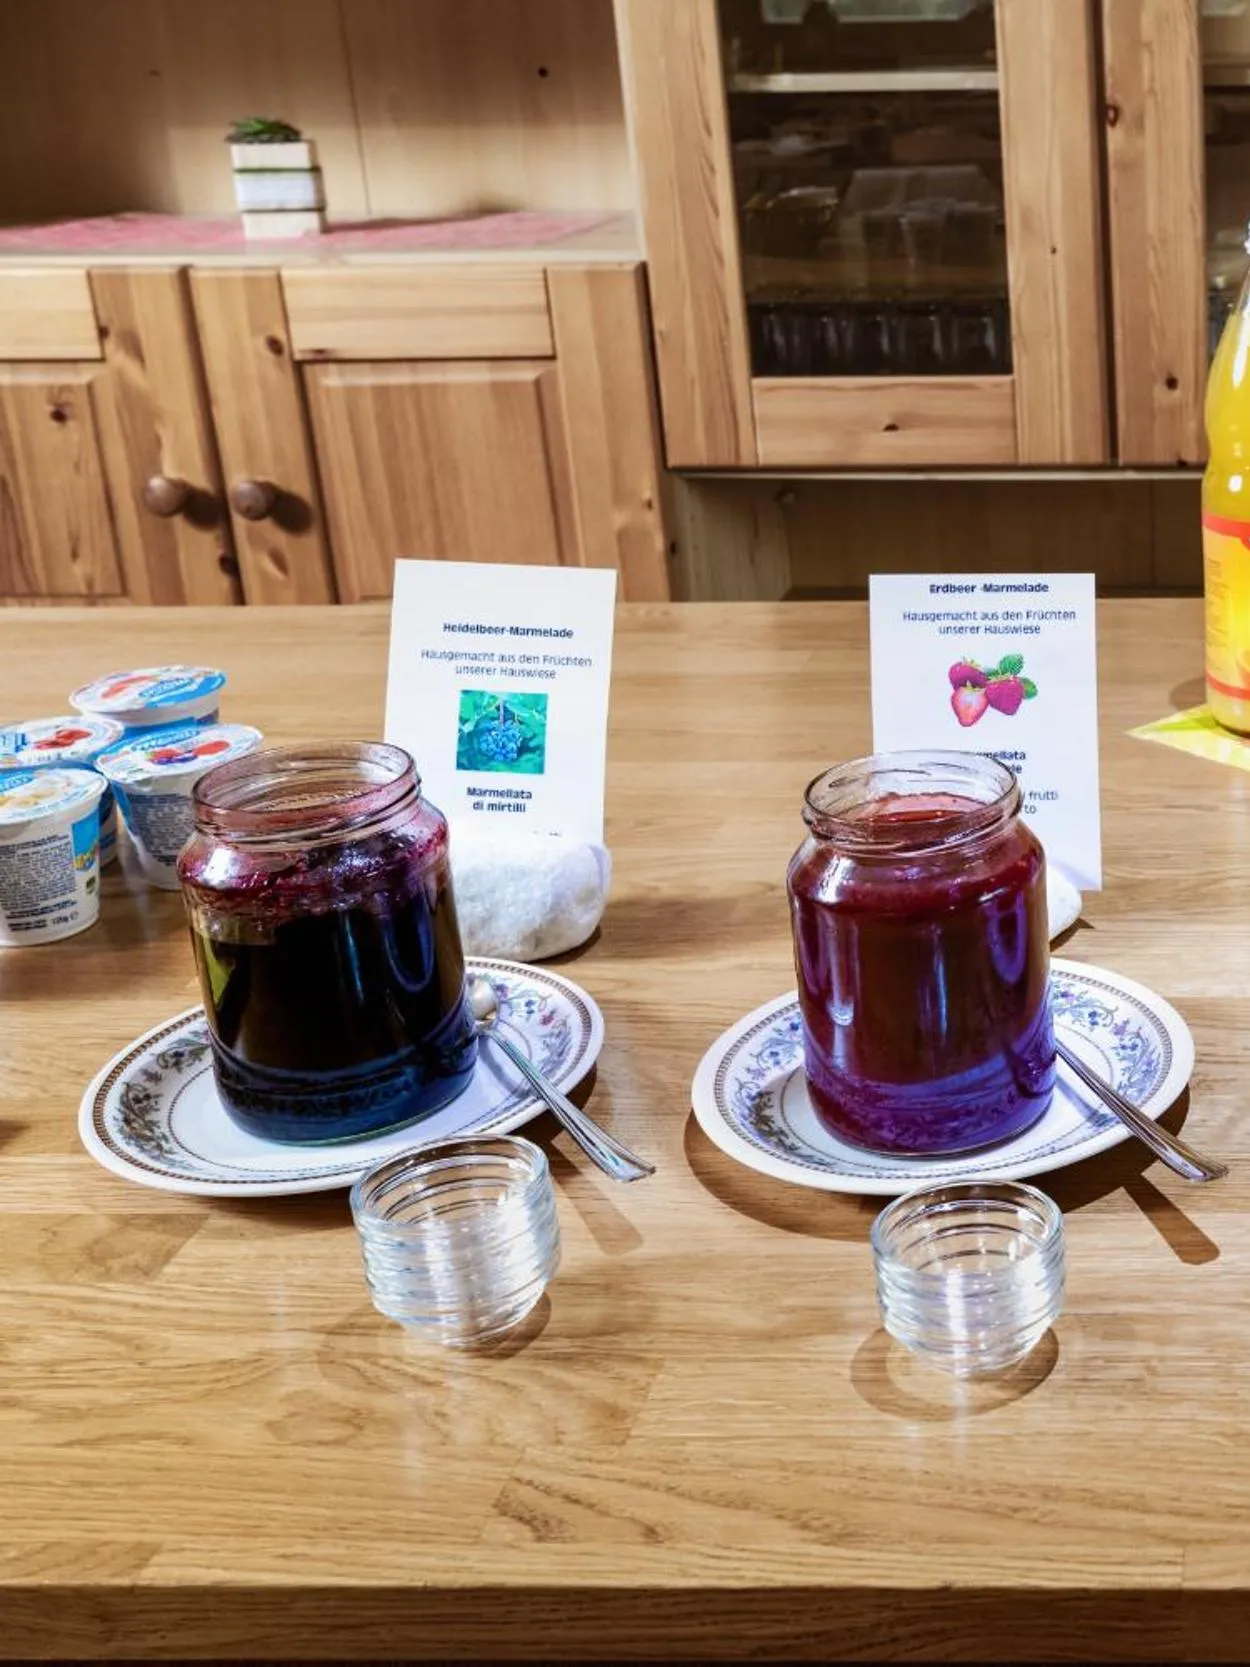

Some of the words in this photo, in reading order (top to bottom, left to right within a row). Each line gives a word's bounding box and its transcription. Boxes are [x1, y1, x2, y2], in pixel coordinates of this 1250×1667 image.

[902, 610, 977, 623] Hausgemacht
[980, 611, 999, 621] aus
[1001, 610, 1023, 621] den
[1026, 609, 1077, 621] Früchten
[443, 622, 574, 639] Heidelbeer-Marmelade
[938, 624, 981, 635] unserer
[984, 623, 1041, 635] Hauswiese
[420, 648, 495, 662] Hausgemacht
[498, 652, 517, 664] aus
[519, 653, 540, 665] den
[542, 653, 593, 668] Früchten
[455, 664, 497, 676] unserer
[500, 665, 557, 680] Hauswiese
[466, 786, 533, 800] Marmellata
[1028, 789, 1059, 801] frutti
[472, 800, 485, 811] di
[487, 801, 526, 813] mirtilli
